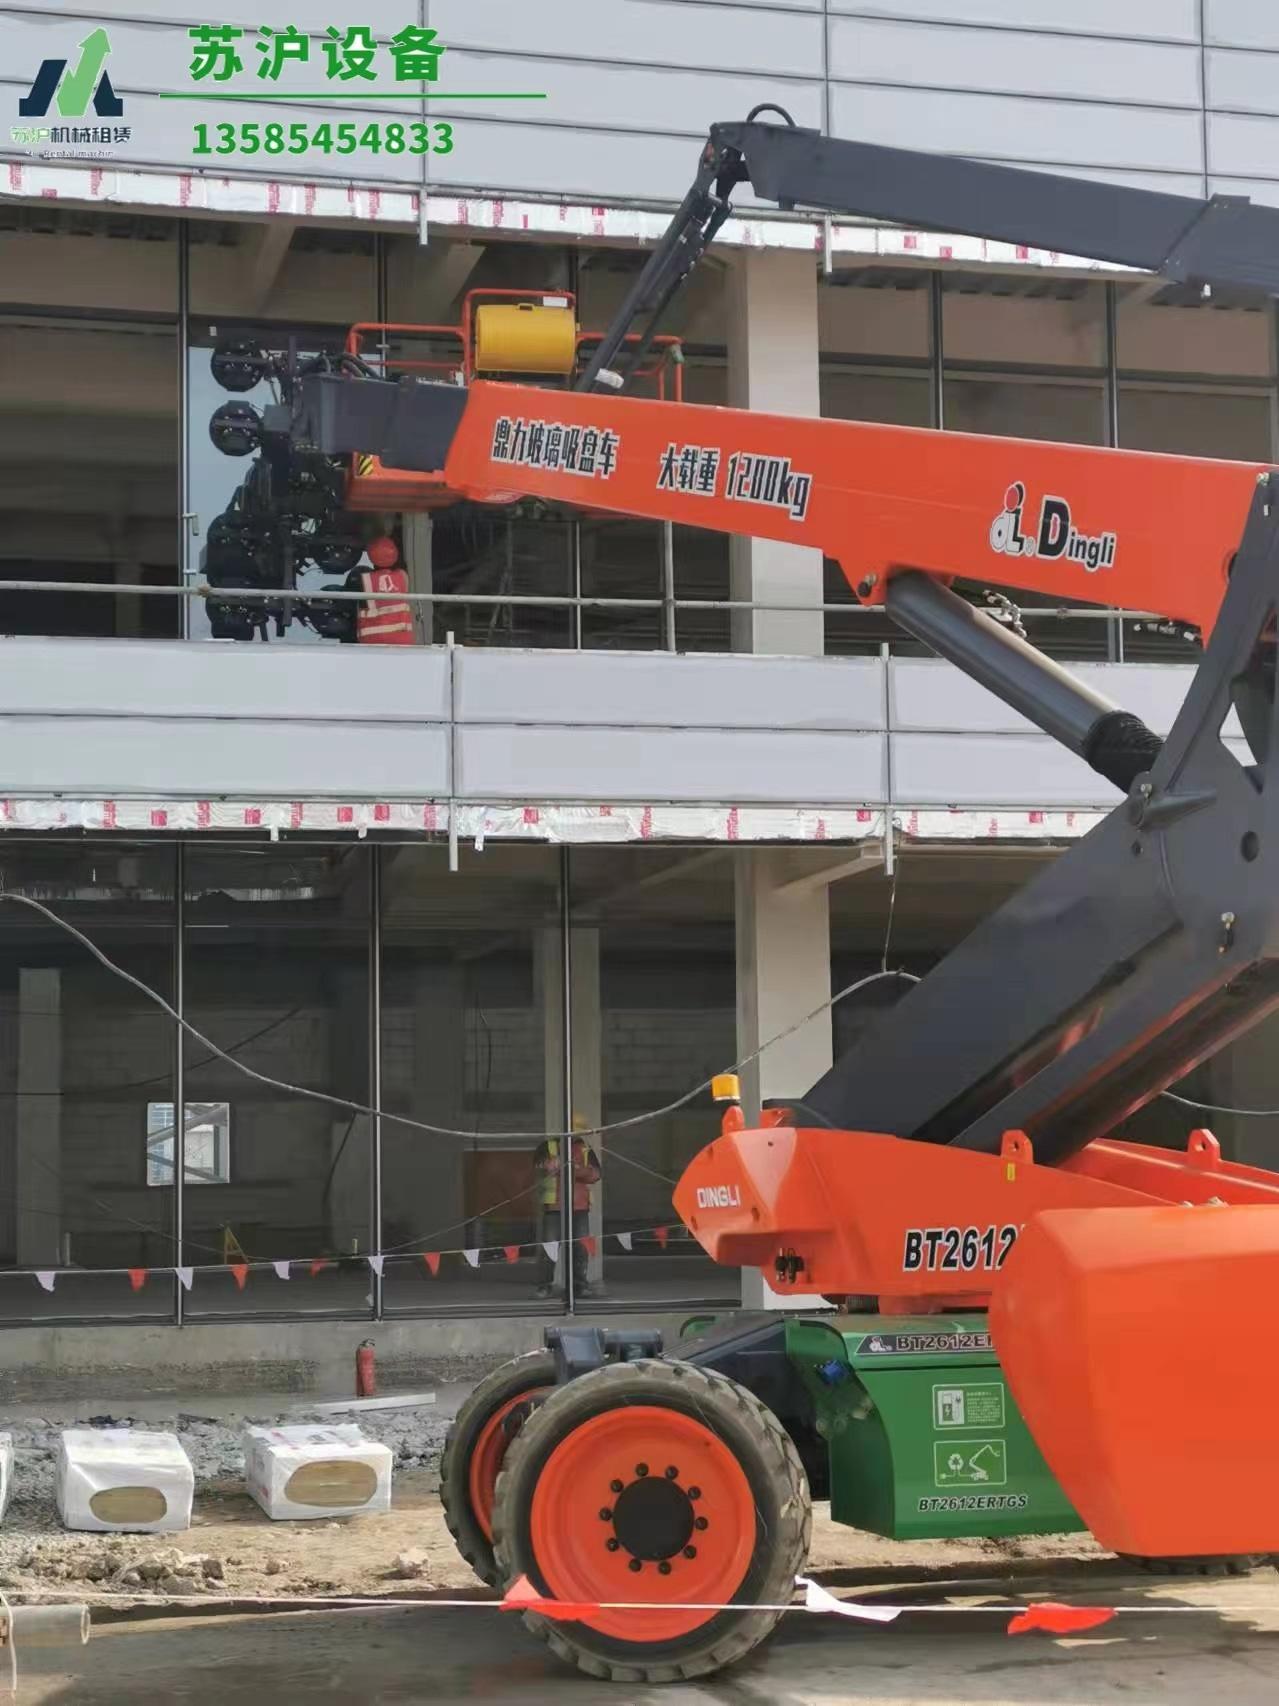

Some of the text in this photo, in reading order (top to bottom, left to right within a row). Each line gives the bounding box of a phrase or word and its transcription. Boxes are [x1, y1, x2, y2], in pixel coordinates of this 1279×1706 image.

[490, 415, 620, 480] 鼎力玻璃吸盘车
[656, 442, 813, 522] 大载重 1200kg
[1036, 494, 1116, 573] Dingli
[696, 1185, 741, 1209] DINGLI
[903, 1223, 1025, 1272] BT2612
[918, 1494, 1029, 1512] BT2612ERTGS
